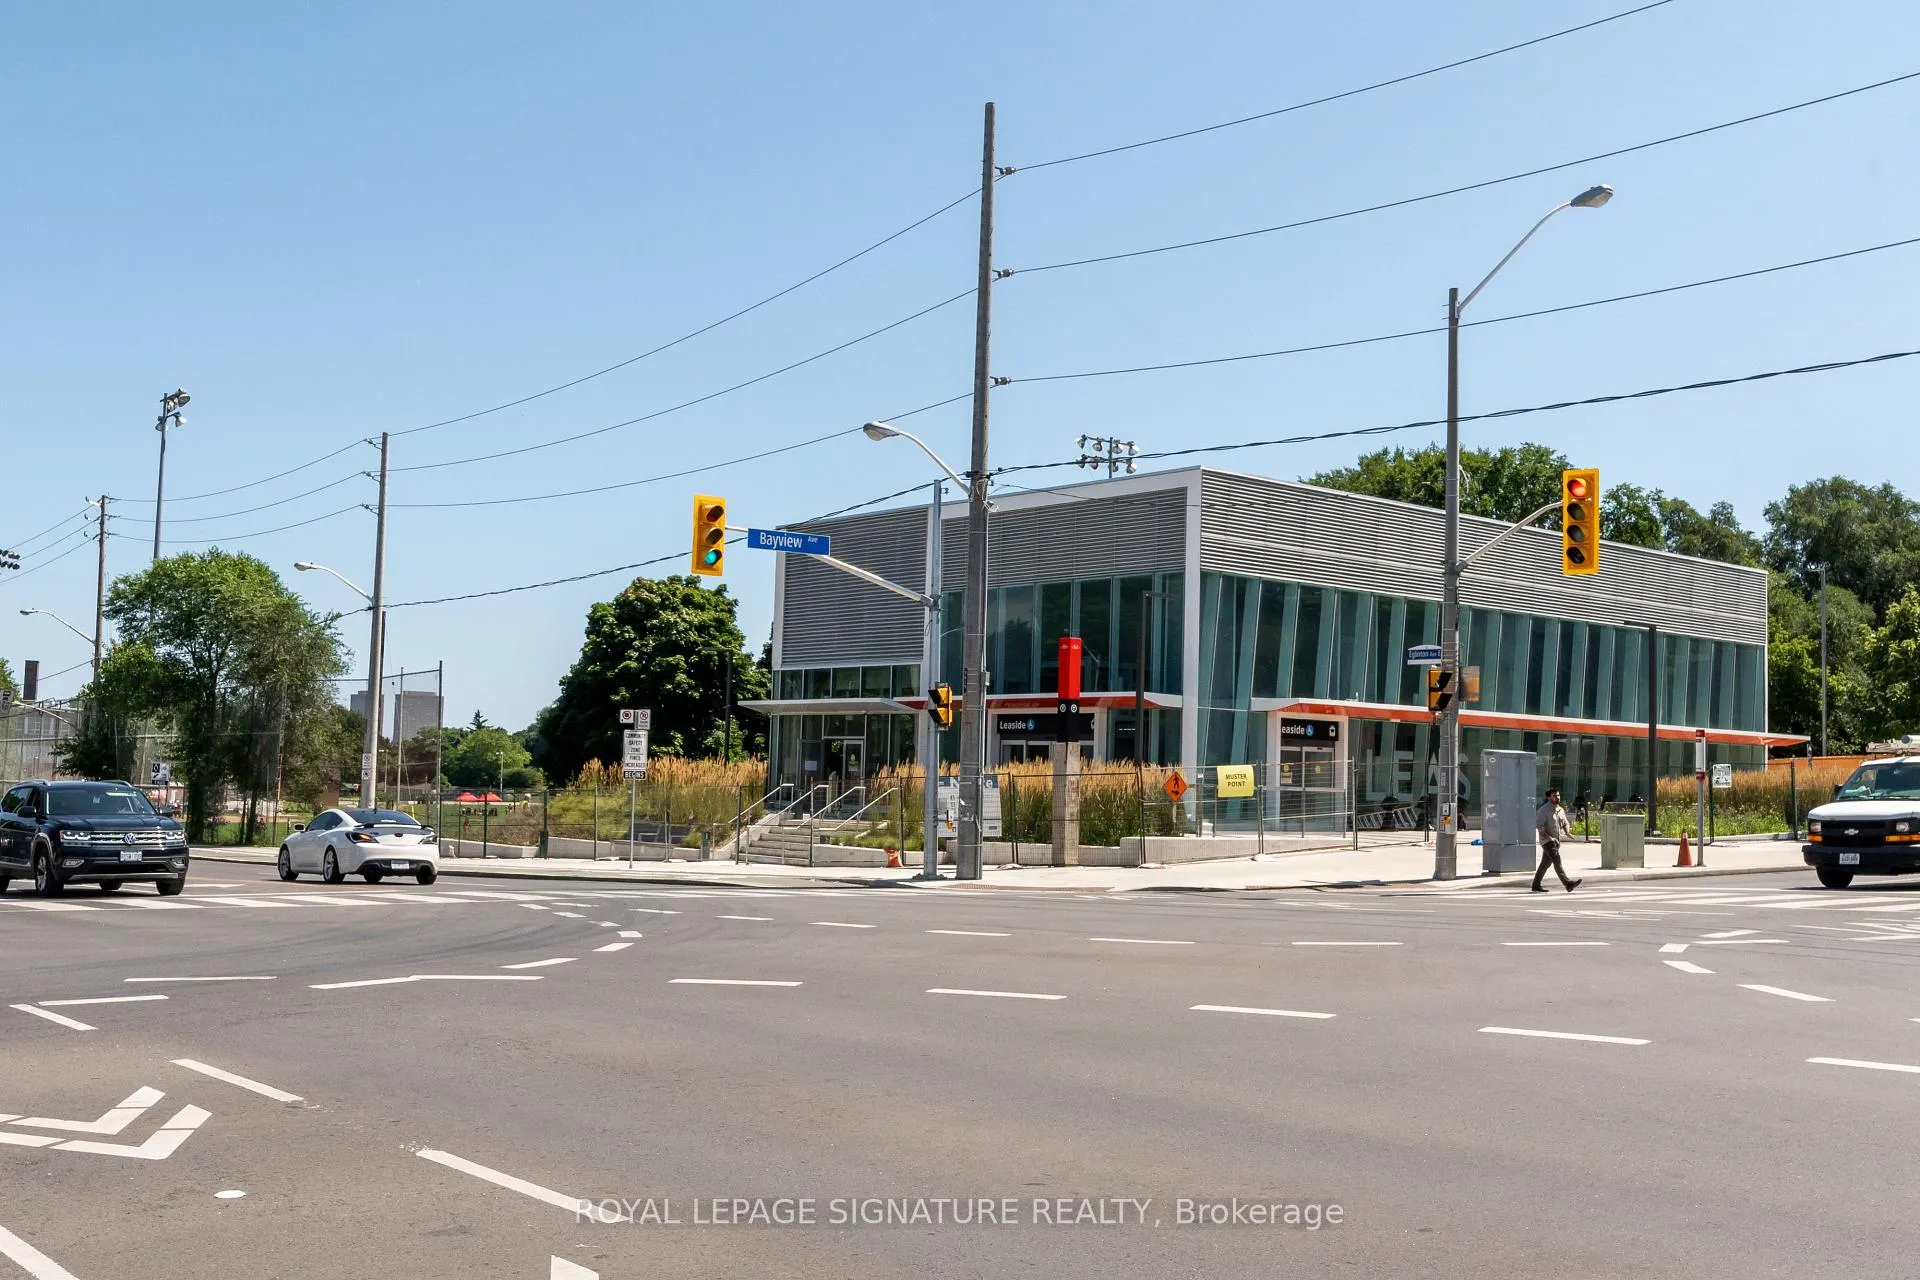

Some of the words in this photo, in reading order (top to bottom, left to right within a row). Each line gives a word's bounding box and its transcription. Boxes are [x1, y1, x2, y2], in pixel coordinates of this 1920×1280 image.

[760, 532, 802, 549] Bayview
[808, 536, 818, 544] Ave
[1409, 650, 1429, 659] Eglinton
[1000, 721, 1026, 729] Leaside
[1281, 725, 1305, 735] easide
[625, 771, 645, 779] BEGINS
